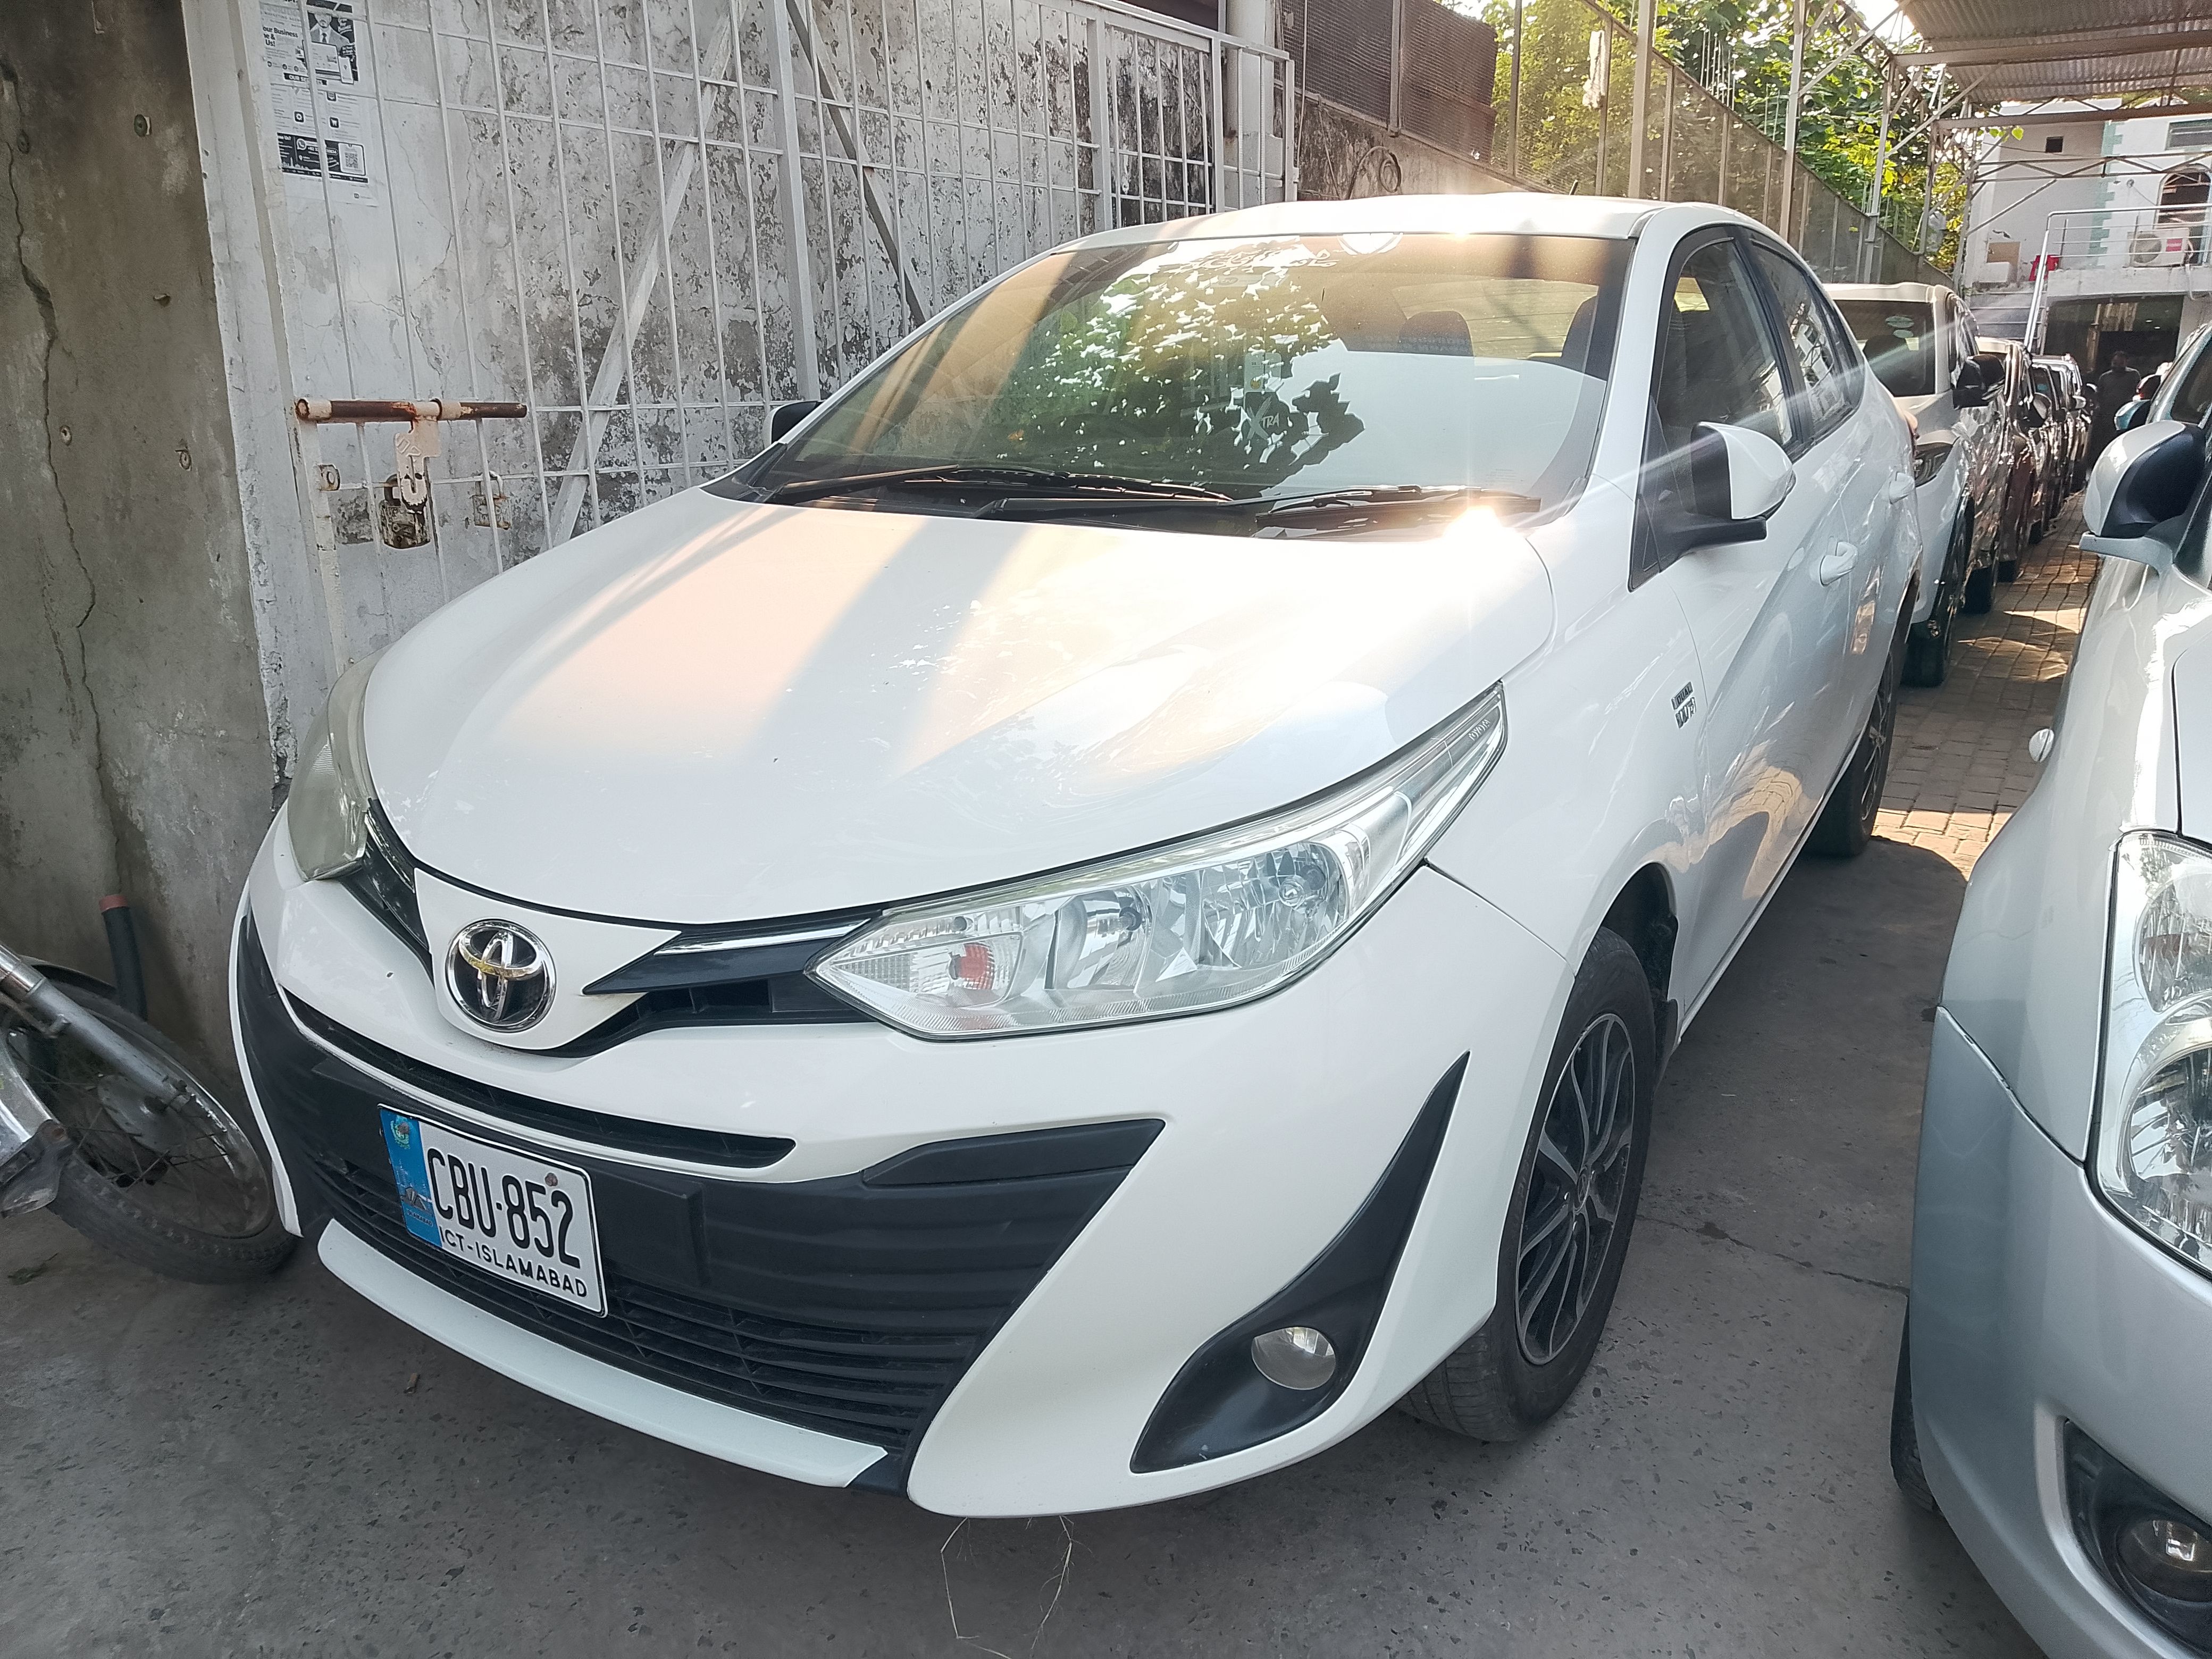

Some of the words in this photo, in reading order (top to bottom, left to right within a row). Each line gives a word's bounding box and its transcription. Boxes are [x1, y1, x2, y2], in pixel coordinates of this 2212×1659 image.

[273, 27, 298, 38] Business
[1677, 685, 1692, 704] DUAL
[1468, 719, 1491, 741] TOYOTA
[439, 1226, 587, 1298] ICT-ISLAMABAD
